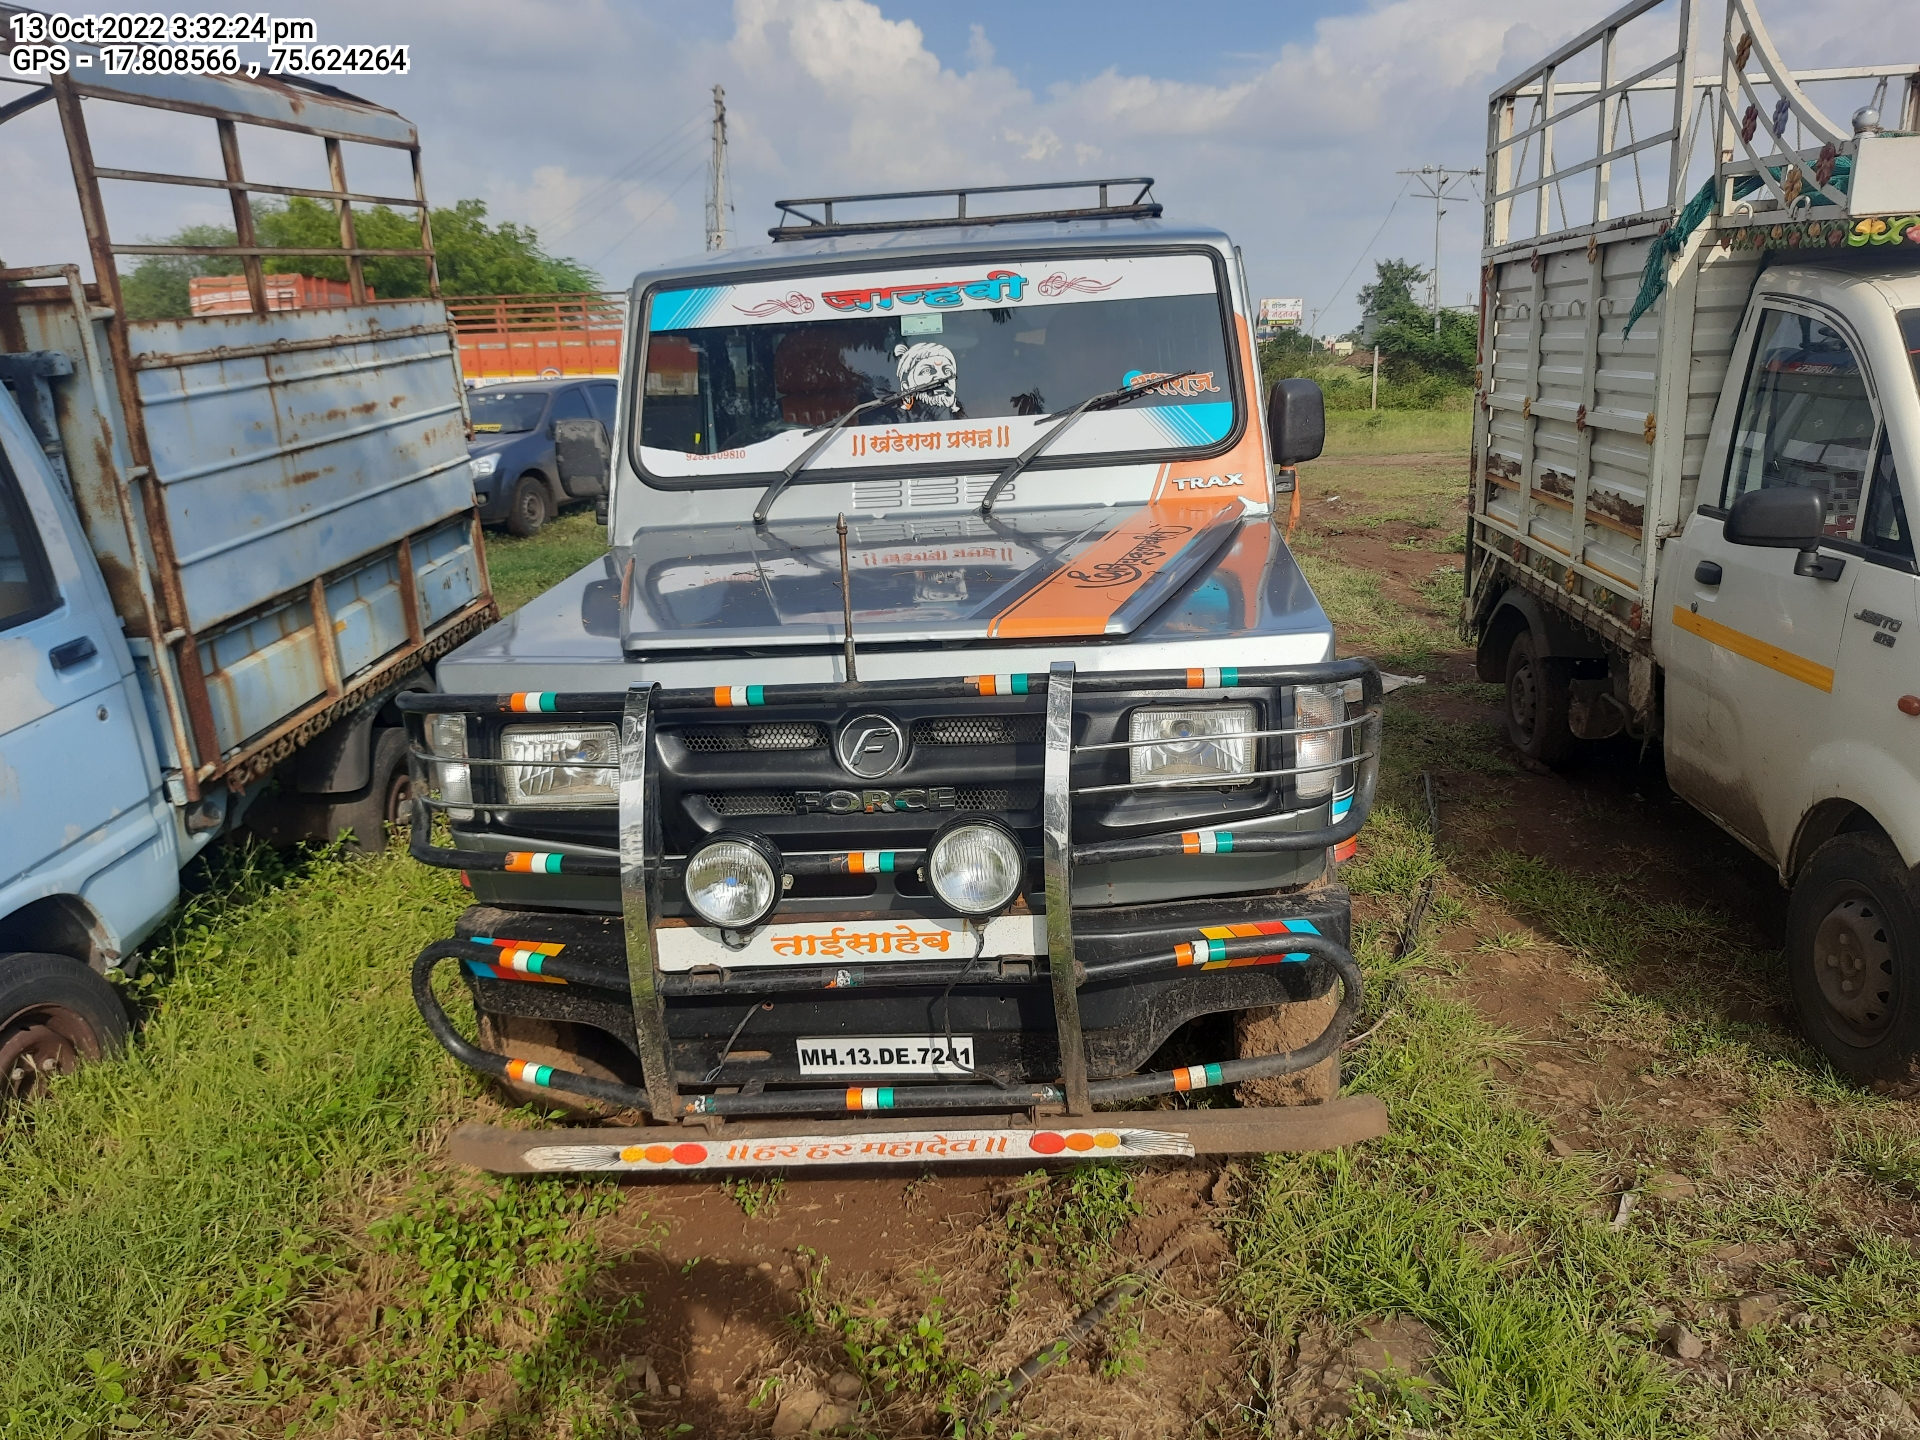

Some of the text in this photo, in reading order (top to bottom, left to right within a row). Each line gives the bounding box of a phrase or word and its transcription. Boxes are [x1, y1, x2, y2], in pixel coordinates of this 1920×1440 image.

[821, 269, 1030, 312] जान्हवी
[1172, 473, 1244, 491] TRAX
[794, 786, 955, 815] FORCE
[770, 924, 952, 958] ताईसाहेब
